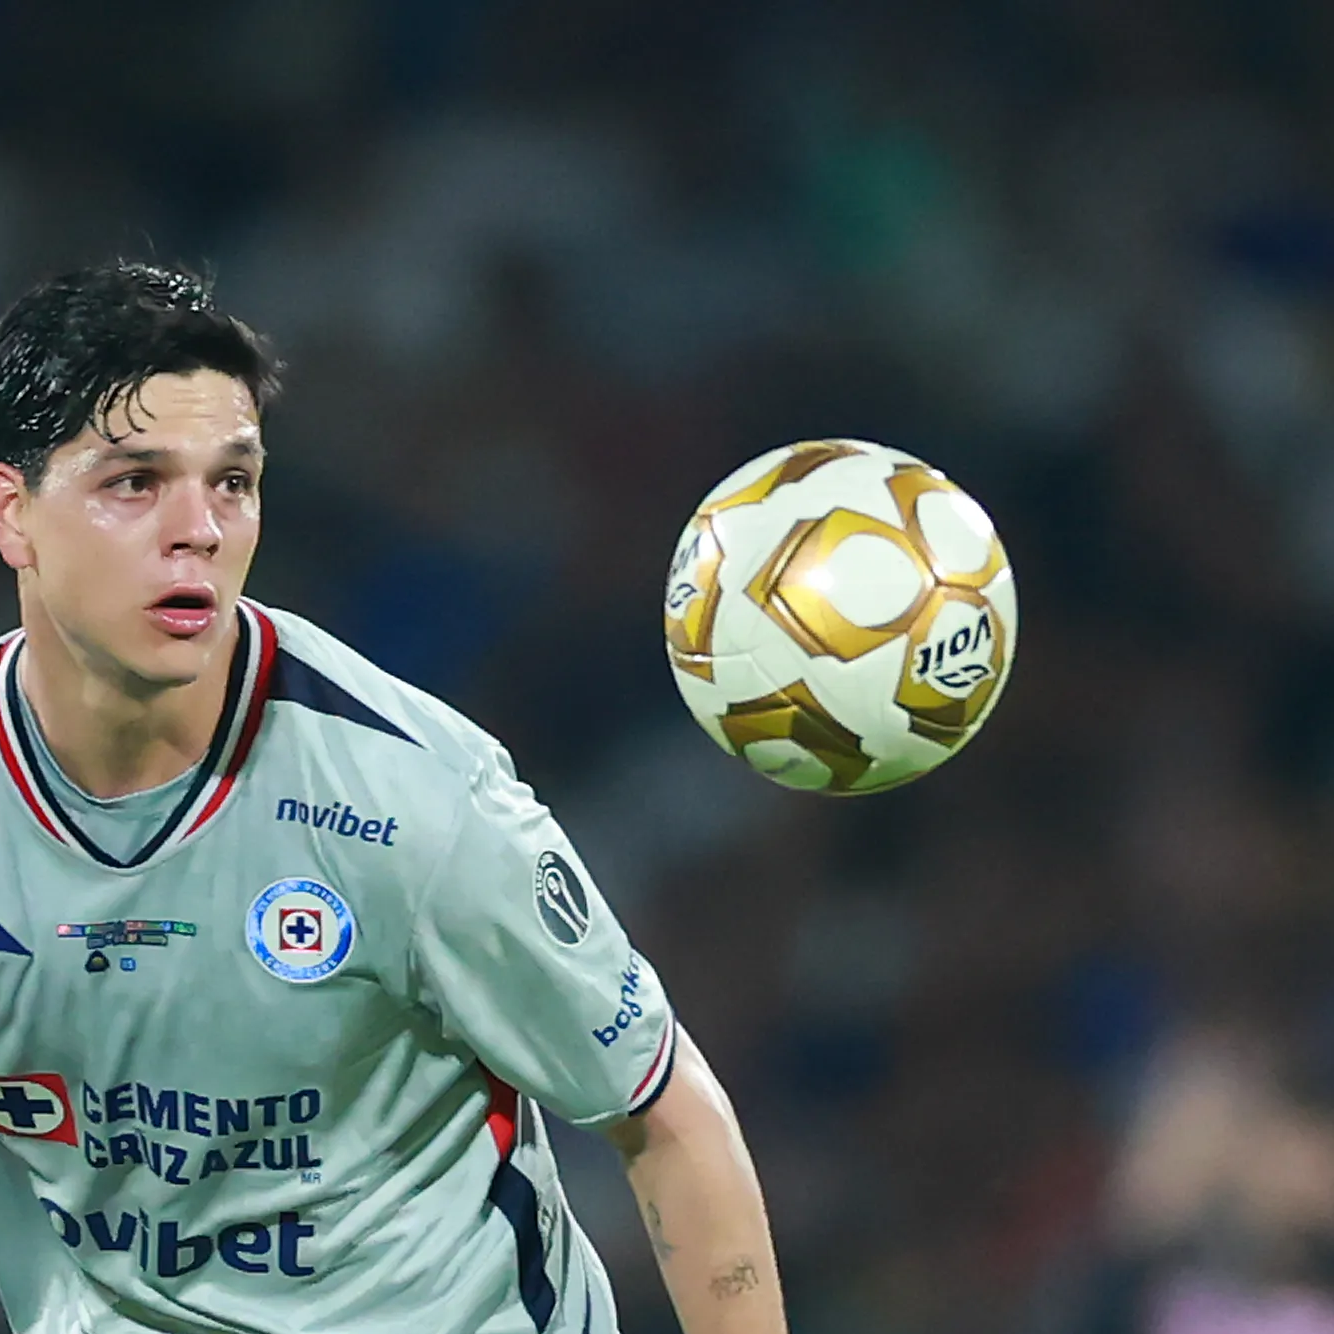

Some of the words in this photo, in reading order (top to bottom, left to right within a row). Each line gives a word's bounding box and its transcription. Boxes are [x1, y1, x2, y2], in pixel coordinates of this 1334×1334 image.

[275, 798, 399, 847] novibet
[83, 1080, 321, 1138] CEMENTO
[83, 1128, 190, 1186] CRUZ
[199, 1134, 322, 1181] AZUL
[39, 1196, 316, 1279] ovibet
